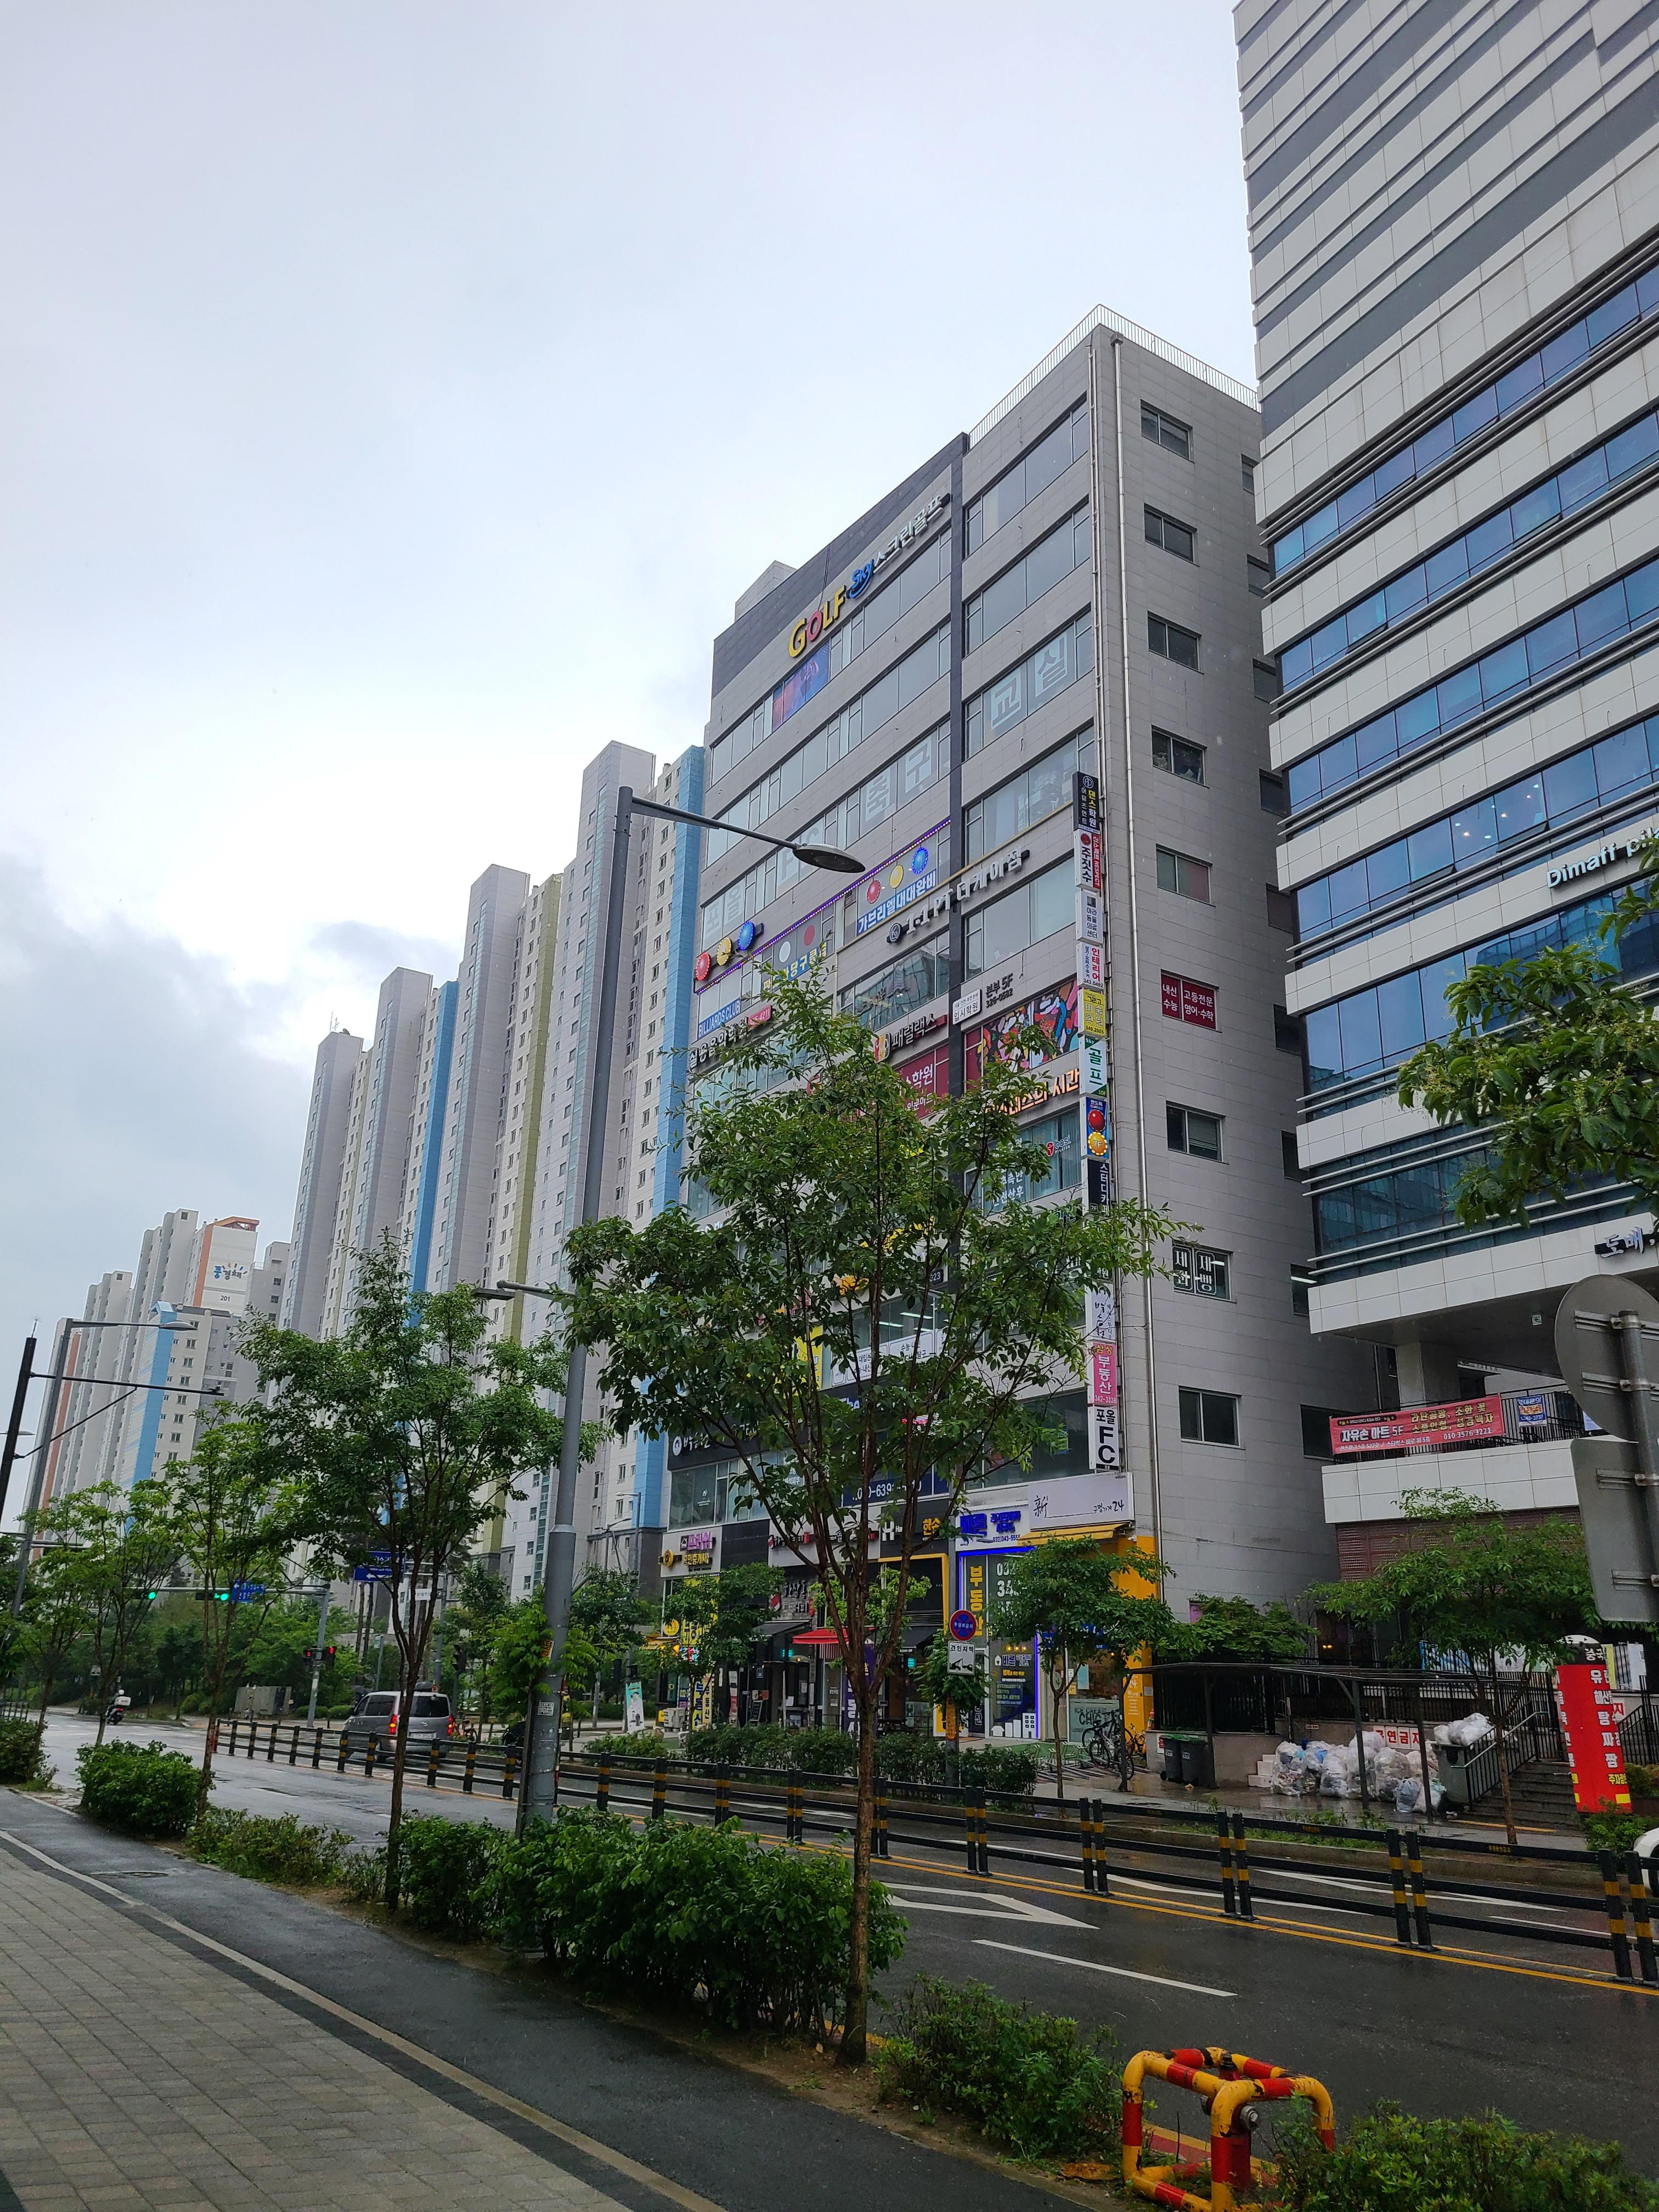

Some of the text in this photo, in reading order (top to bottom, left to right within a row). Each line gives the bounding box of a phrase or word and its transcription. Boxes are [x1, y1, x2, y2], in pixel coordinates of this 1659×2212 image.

[789, 585, 847, 657] GOLF
[873, 495, 944, 573] 스크린골프
[867, 637, 1066, 816] 축구 교실
[1088, 789, 1097, 828] 댄스학원
[1082, 847, 1091, 882] 주짓수
[1547, 843, 1616, 888] Dimaff
[934, 888, 953, 917] PT
[1092, 947, 1101, 982] 인테리어
[985, 973, 1013, 998] 본부 5F
[1163, 984, 1213, 1007] 내신 고등전문
[955, 1001, 978, 1022] 입시학원
[1163, 998, 1178, 1011] 수능
[892, 1014, 937, 1047] 패럴랙스
[1089, 1047, 1103, 1085] 골프
[1053, 1068, 1080, 1097] 시간
[1093, 1139, 1102, 1148] 7F
[1099, 1163, 1110, 1216] 스터디카페
[213, 1265, 242, 1280] 풍경채
[1199, 1255, 1214, 1291] 제빵
[1097, 1344, 1113, 1356] 삼성
[1098, 1355, 1112, 1395] 부동산
[1096, 1408, 1115, 1425] 포올
[1455, 1404, 1473, 1417] 조화
[1098, 1426, 1115, 1464] FC
[1341, 1428, 1369, 1442] 자유손
[1392, 1425, 1404, 1436] 5F
[1457, 1430, 1474, 1438] 3576
[1475, 1427, 1492, 1435] 3221
[1034, 1494, 1049, 1519] 新
[1112, 1499, 1124, 1512] 24
[951, 1645, 974, 1654] 견인지역
